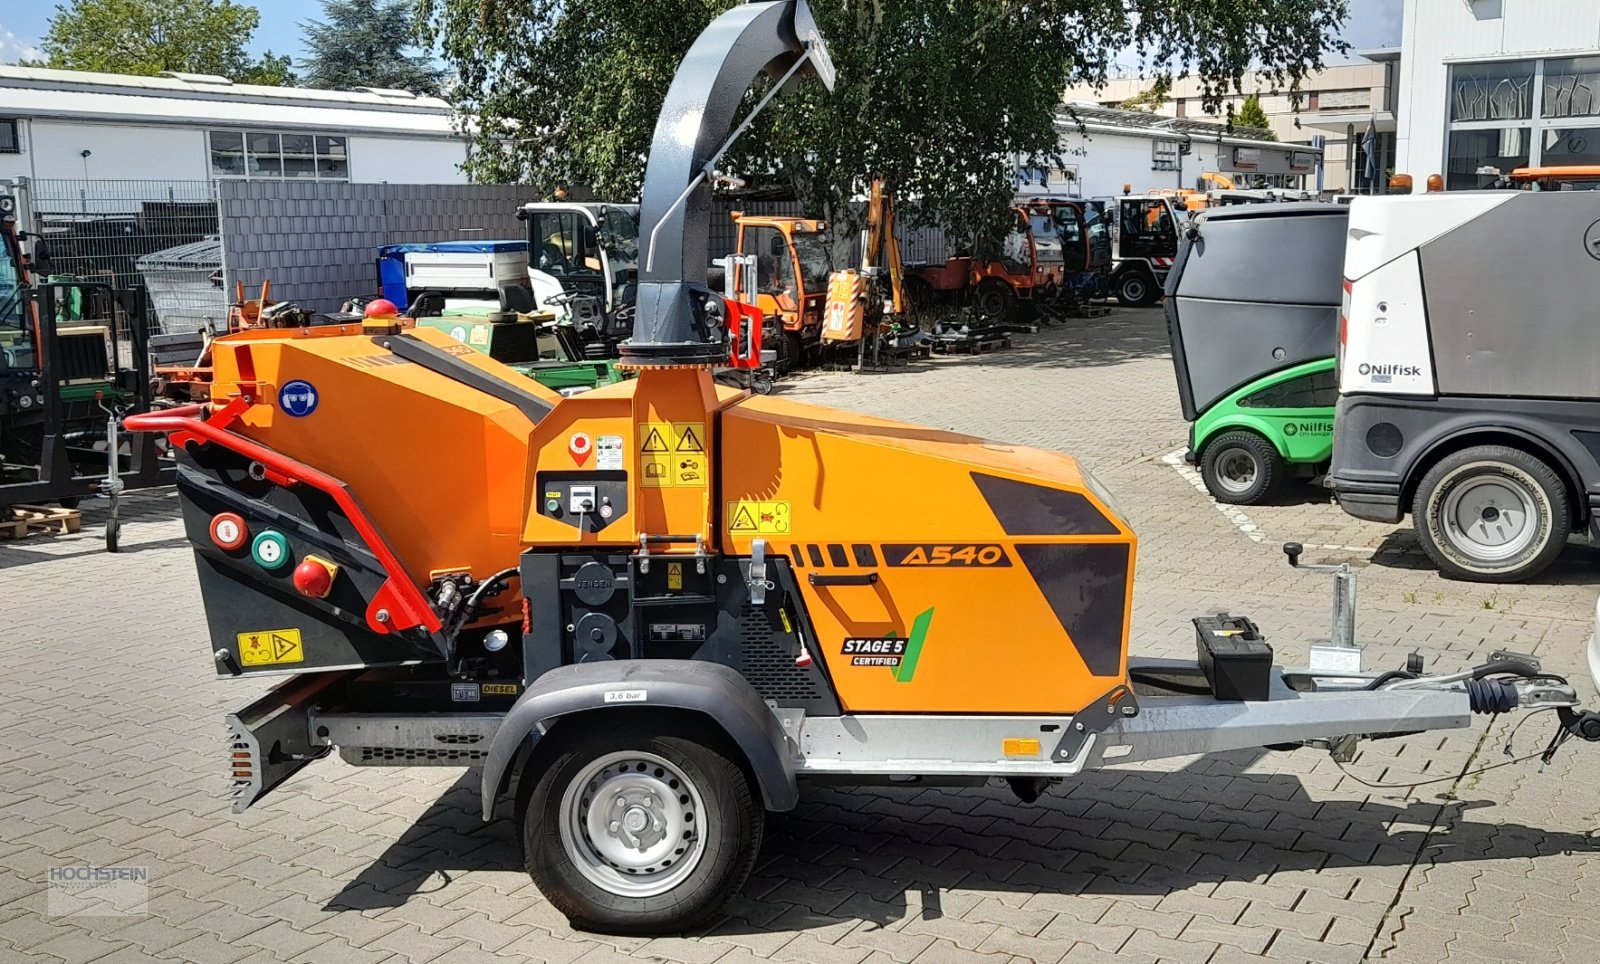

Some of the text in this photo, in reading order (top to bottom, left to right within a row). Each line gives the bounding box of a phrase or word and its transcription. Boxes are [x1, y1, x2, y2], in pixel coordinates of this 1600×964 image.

[1371, 364, 1421, 376] Nilfisk
[1300, 422, 1334, 432] Nilfis
[900, 546, 1002, 565] A540
[844, 640, 904, 653] STAGE 5
[853, 657, 898, 665] CERTIFIED
[484, 685, 515, 693] DIESEL
